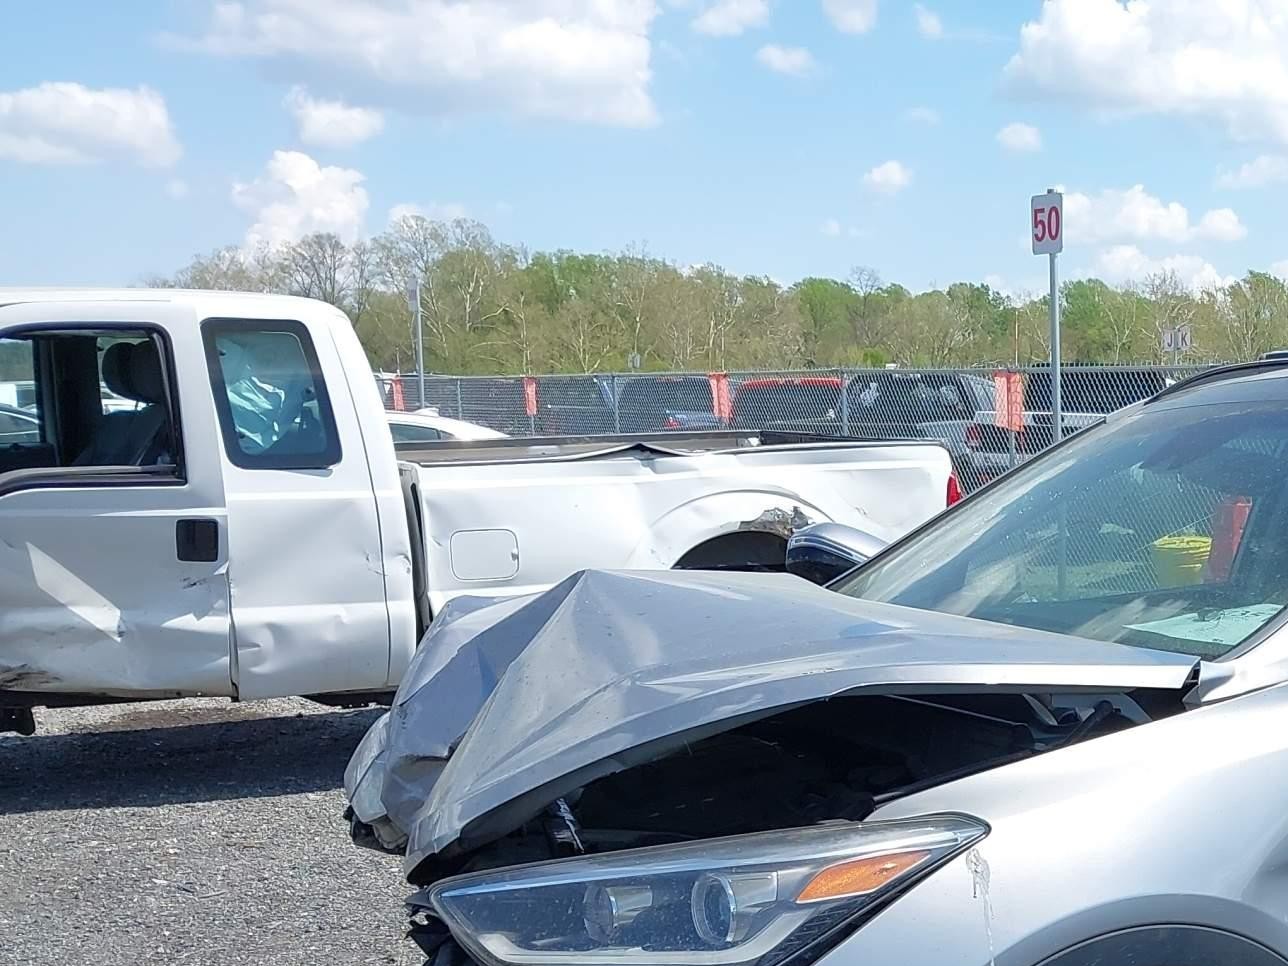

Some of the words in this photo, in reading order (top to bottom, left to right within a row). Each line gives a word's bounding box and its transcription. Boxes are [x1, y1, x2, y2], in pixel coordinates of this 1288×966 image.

[1033, 205, 1060, 242] 50
[1167, 332, 1173, 347] J
[1181, 331, 1189, 347] K
